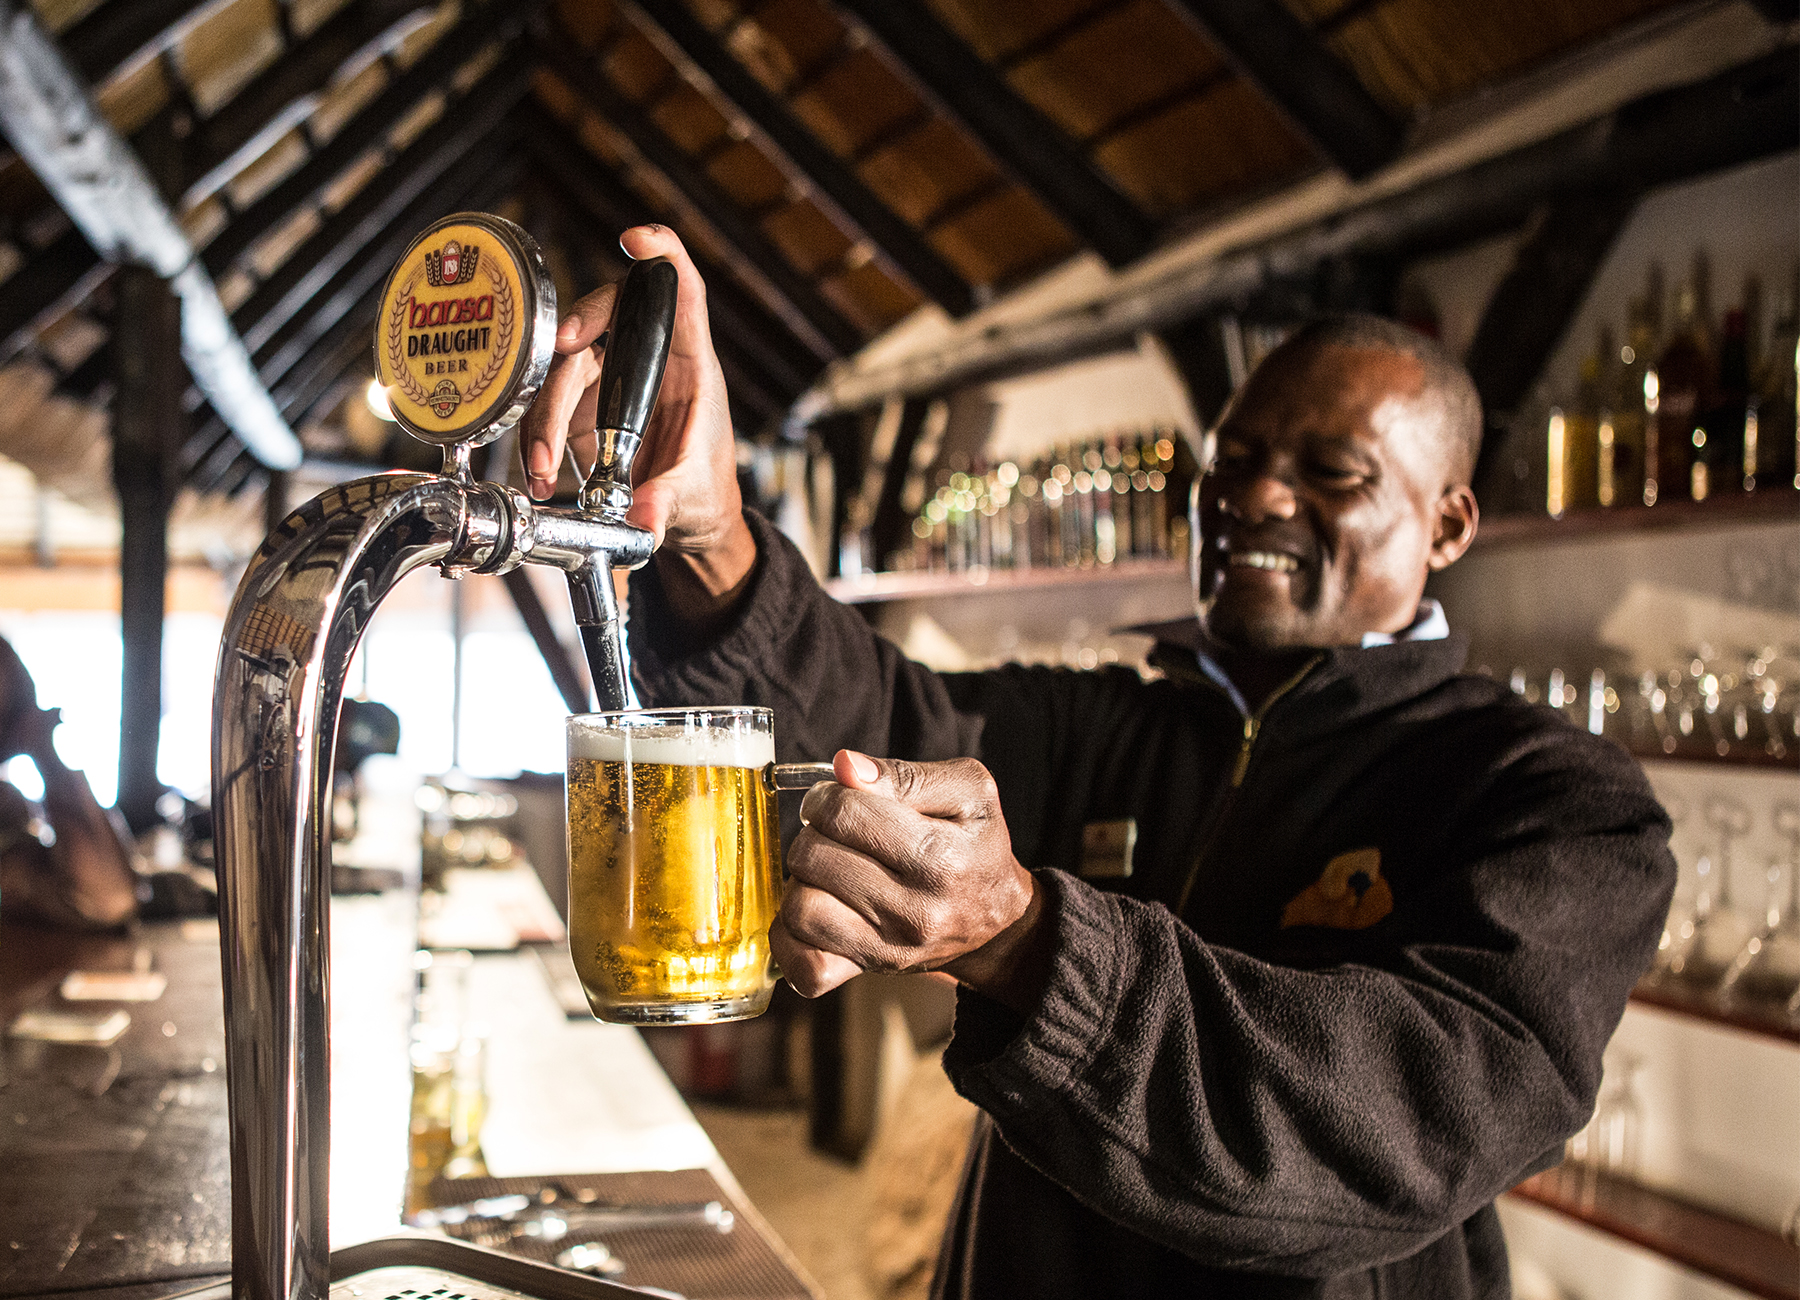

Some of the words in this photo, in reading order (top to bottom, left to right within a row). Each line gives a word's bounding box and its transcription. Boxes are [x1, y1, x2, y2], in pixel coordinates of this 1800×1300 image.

[409, 295, 494, 329] hansa
[408, 327, 490, 357] DRAUGHT
[425, 359, 468, 375] BEER
